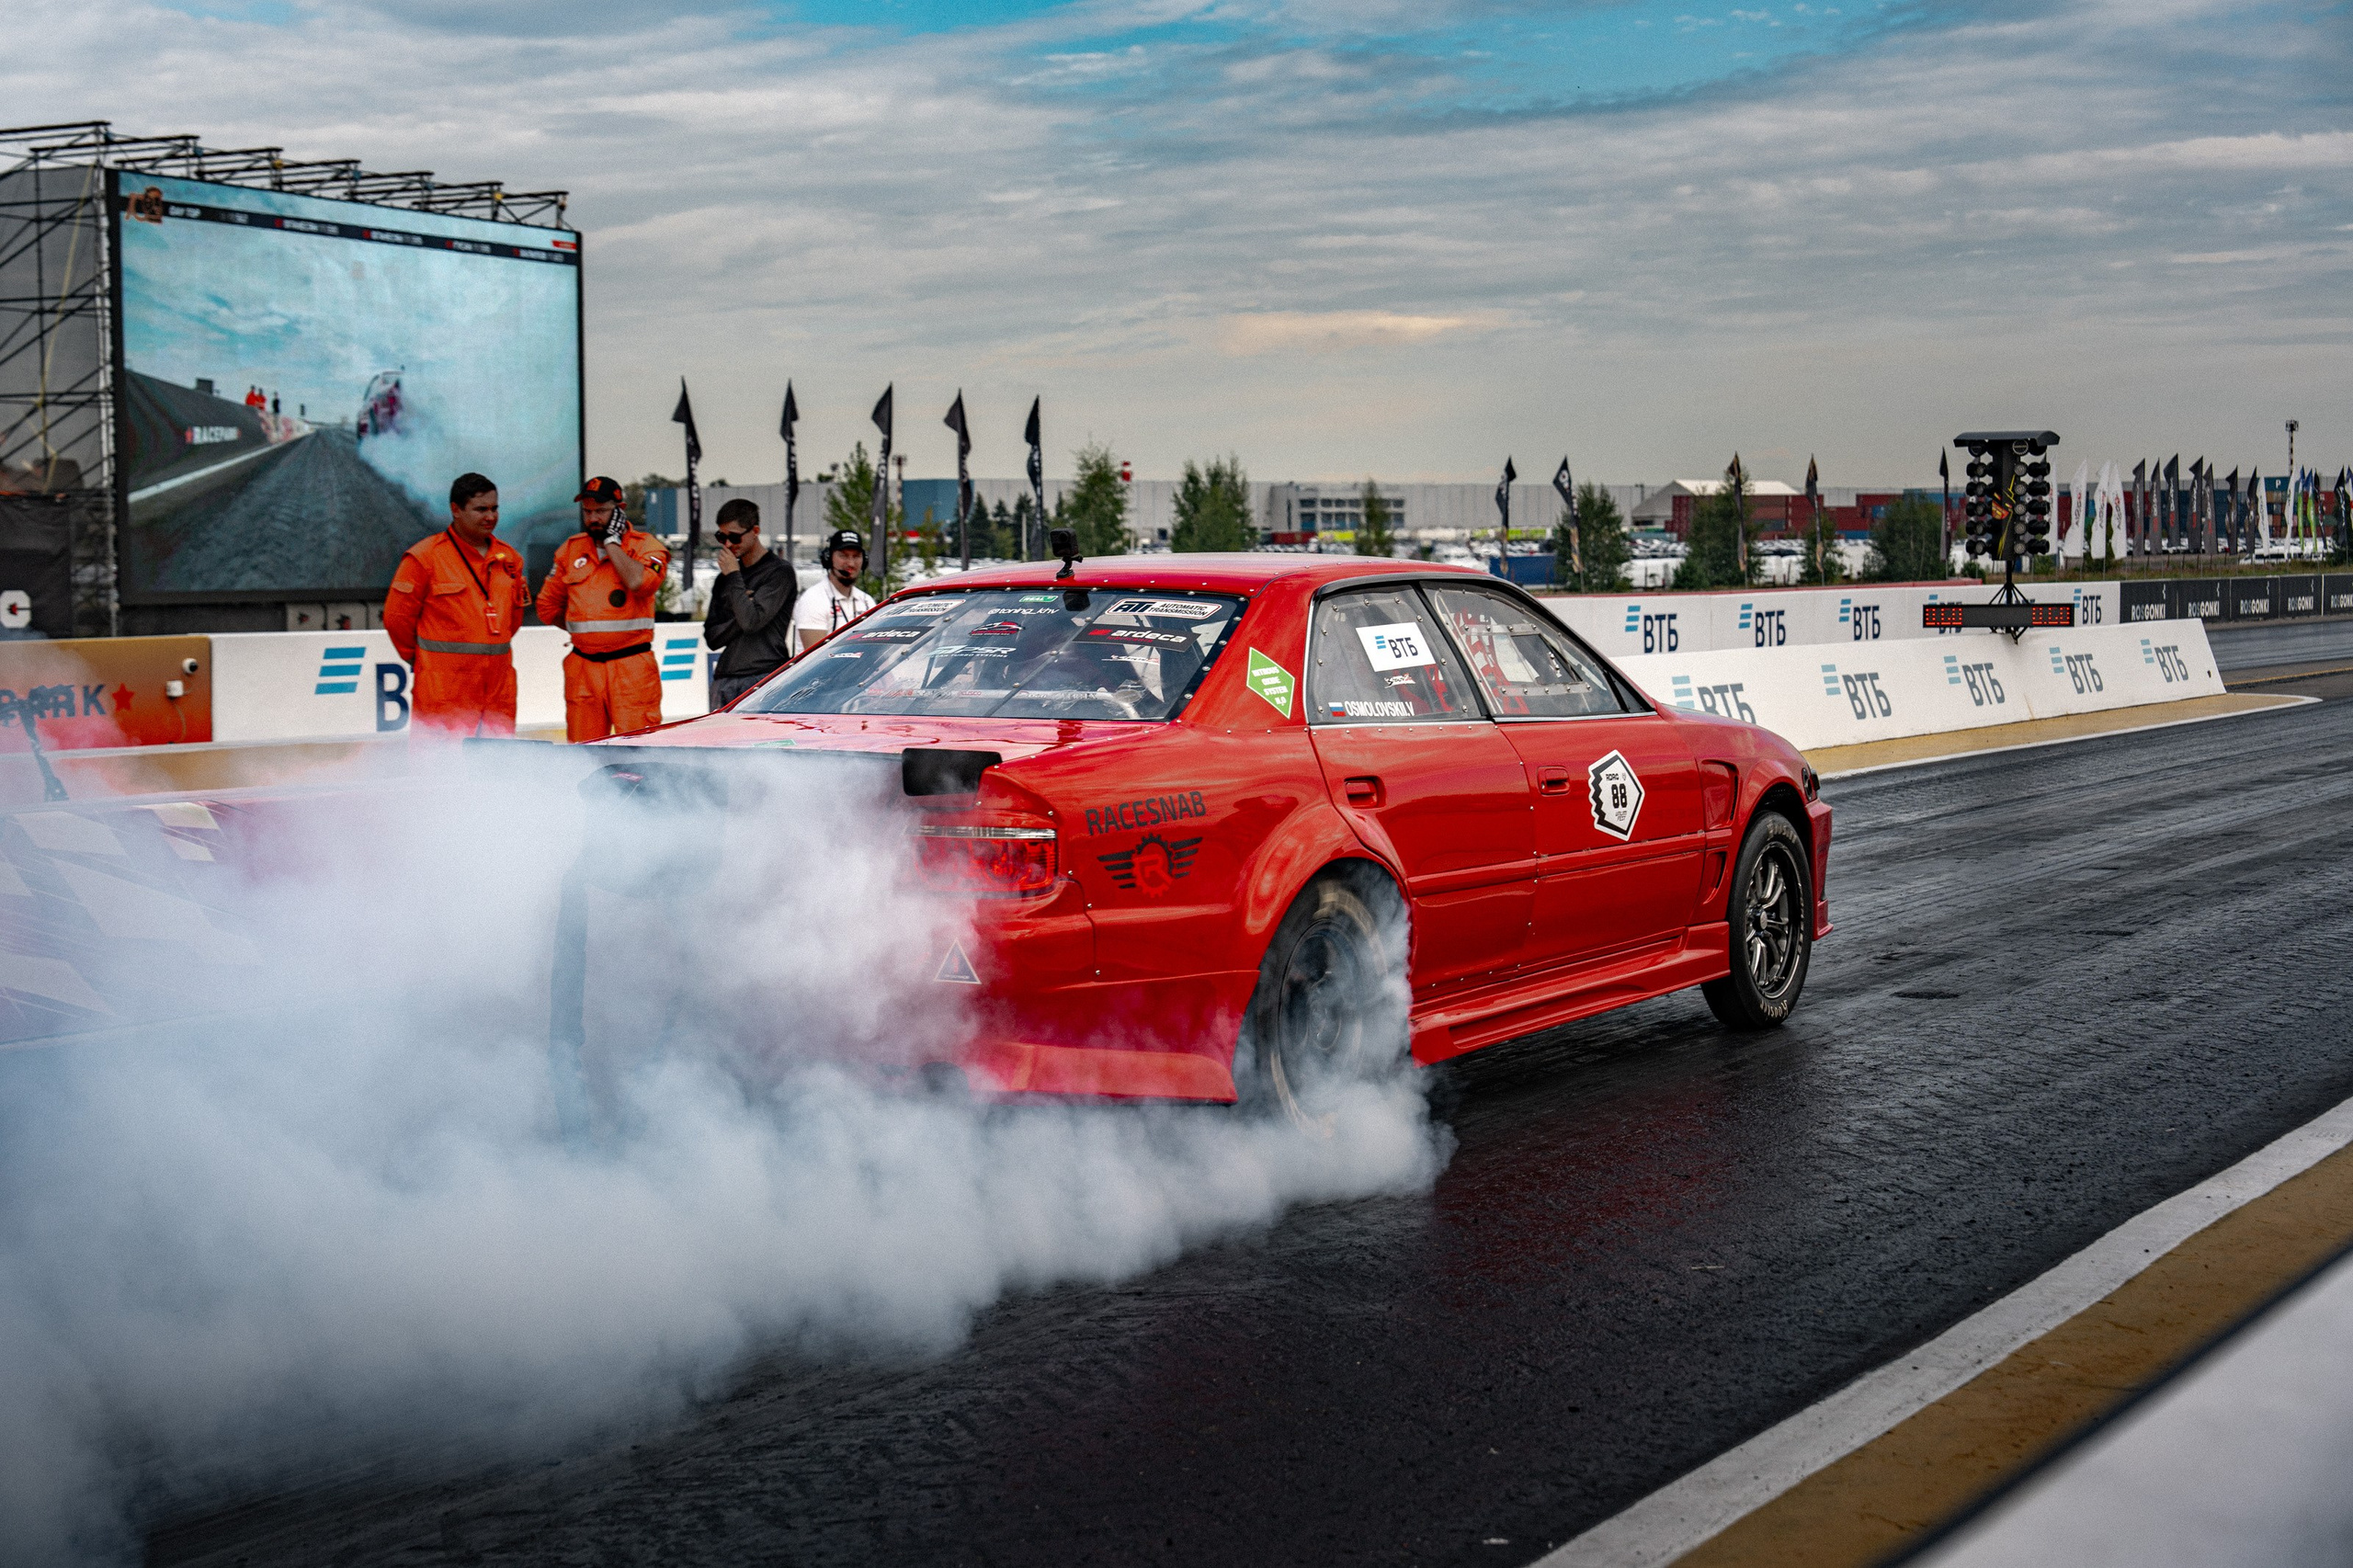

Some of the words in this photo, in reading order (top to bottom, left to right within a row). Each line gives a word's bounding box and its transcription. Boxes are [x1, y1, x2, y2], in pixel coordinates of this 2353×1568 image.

[1148, 607, 1209, 616] TRANSMISSION
[1159, 603, 1207, 611] AUTOMATIC
[2082, 595, 2102, 625] ВТБ
[2131, 603, 2166, 621] ROSGONKI
[2188, 600, 2221, 618] ROSGONKI
[2330, 593, 2353, 608] ROSGONK
[861, 630, 921, 638] ardeca
[1110, 630, 1188, 643] ardeca
[1643, 613, 1679, 653] ВТБ
[1755, 609, 1787, 648] ВТБ
[1853, 605, 1881, 641] ВТБ
[1388, 637, 1418, 658] ВТБ
[2064, 653, 2104, 694] ВТБ
[2154, 645, 2189, 683] ВТБ
[1842, 672, 1892, 720] ВТБ
[1961, 663, 2006, 706] ВТБ
[1698, 683, 1757, 724] ВТБ
[1610, 783, 1628, 809] 88
[1085, 790, 1207, 835] RACESNAB
